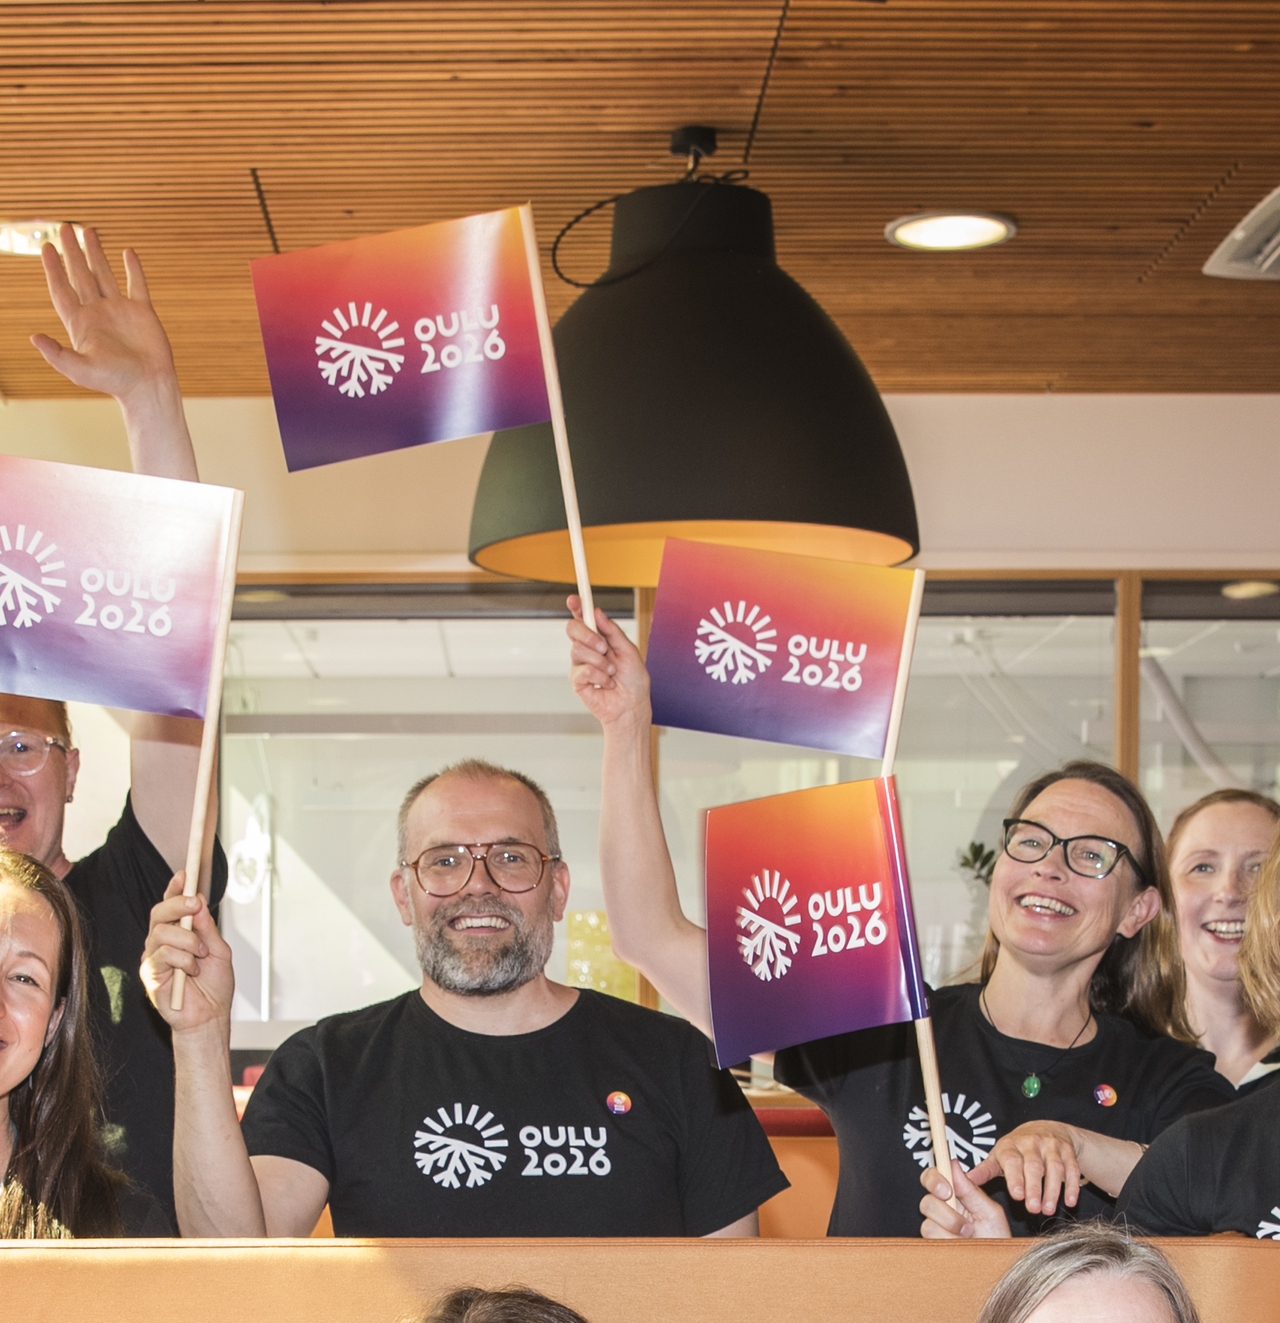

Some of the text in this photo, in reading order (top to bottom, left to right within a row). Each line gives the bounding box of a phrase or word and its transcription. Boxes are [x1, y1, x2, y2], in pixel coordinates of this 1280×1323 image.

[414, 304, 500, 342] OULU
[420, 328, 506, 374] 2026
[79, 566, 177, 603] OULU
[74, 599, 173, 637] 2026
[787, 634, 867, 664] OULU
[781, 655, 862, 692] 2026
[808, 881, 882, 920] OULU
[811, 910, 888, 957] 2026
[519, 1125, 608, 1148] OULU
[521, 1147, 611, 1176] 2026
